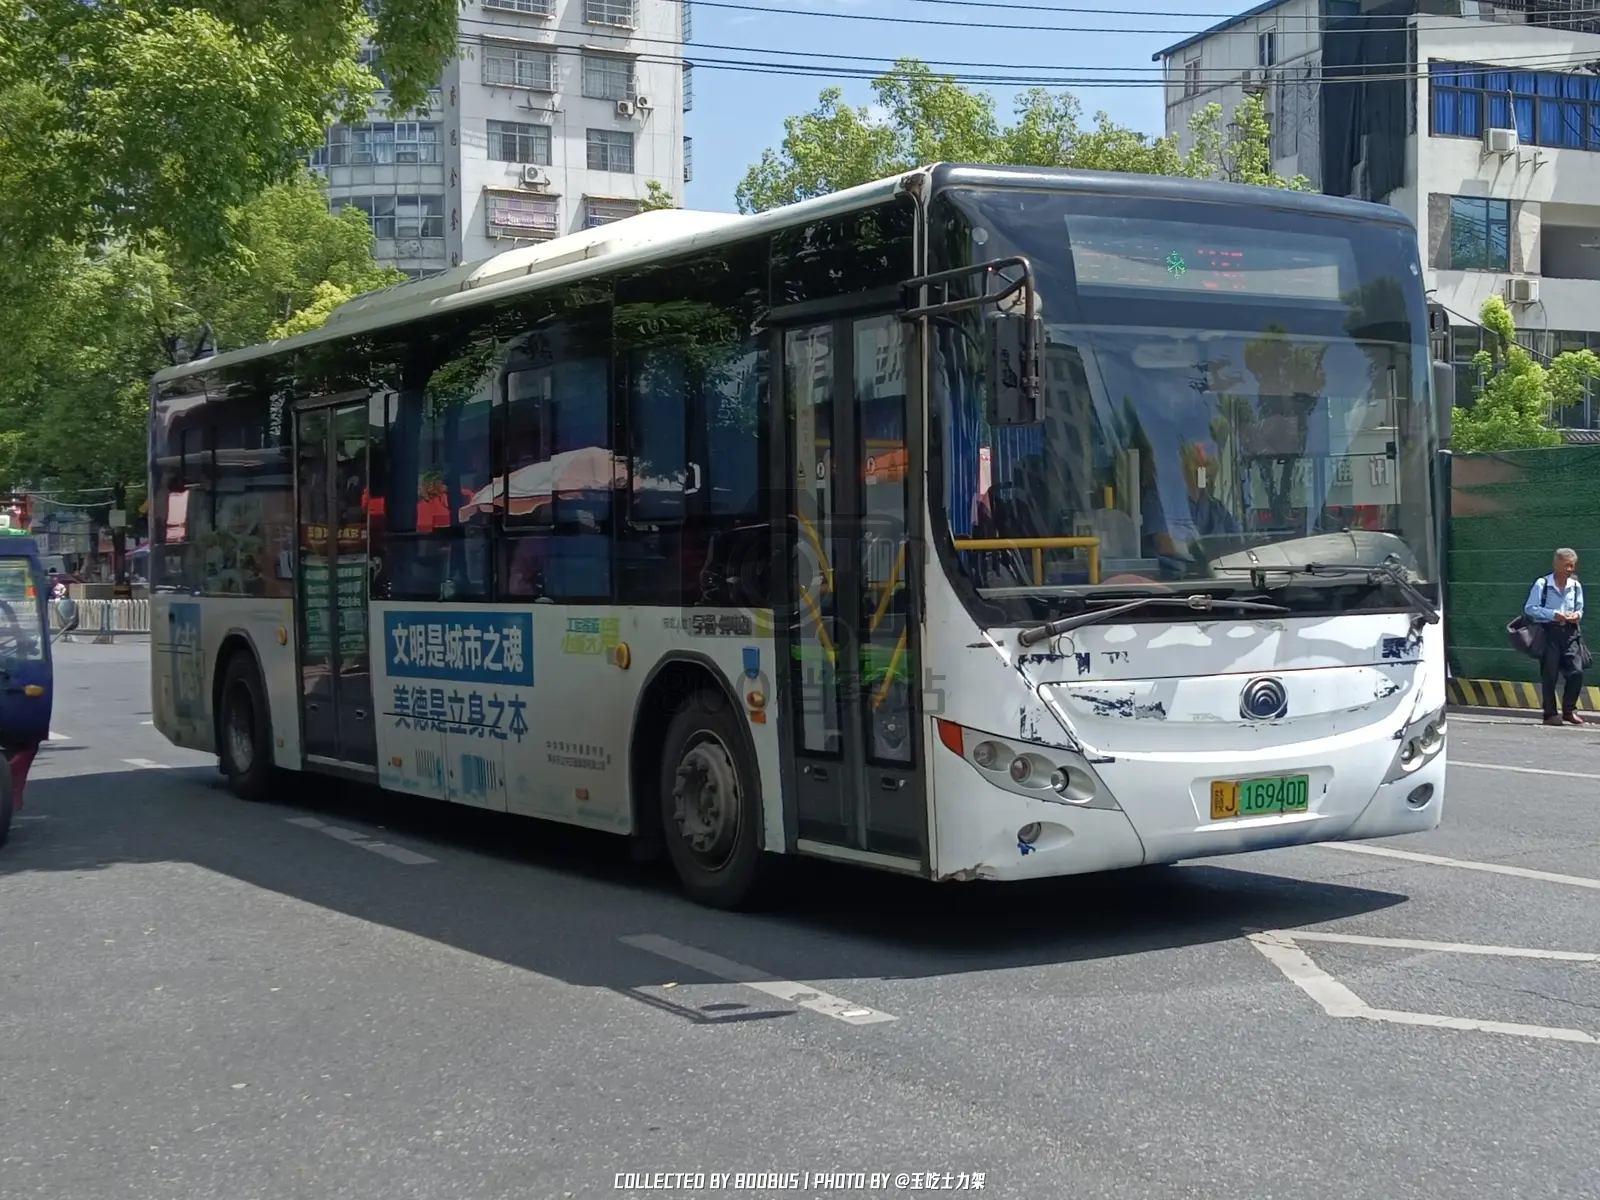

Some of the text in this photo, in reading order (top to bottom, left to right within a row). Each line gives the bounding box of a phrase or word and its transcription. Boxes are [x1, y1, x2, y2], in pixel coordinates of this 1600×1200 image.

[391, 622, 524, 673] 文明是城市之魂
[392, 683, 529, 743] 美德是立身之本
